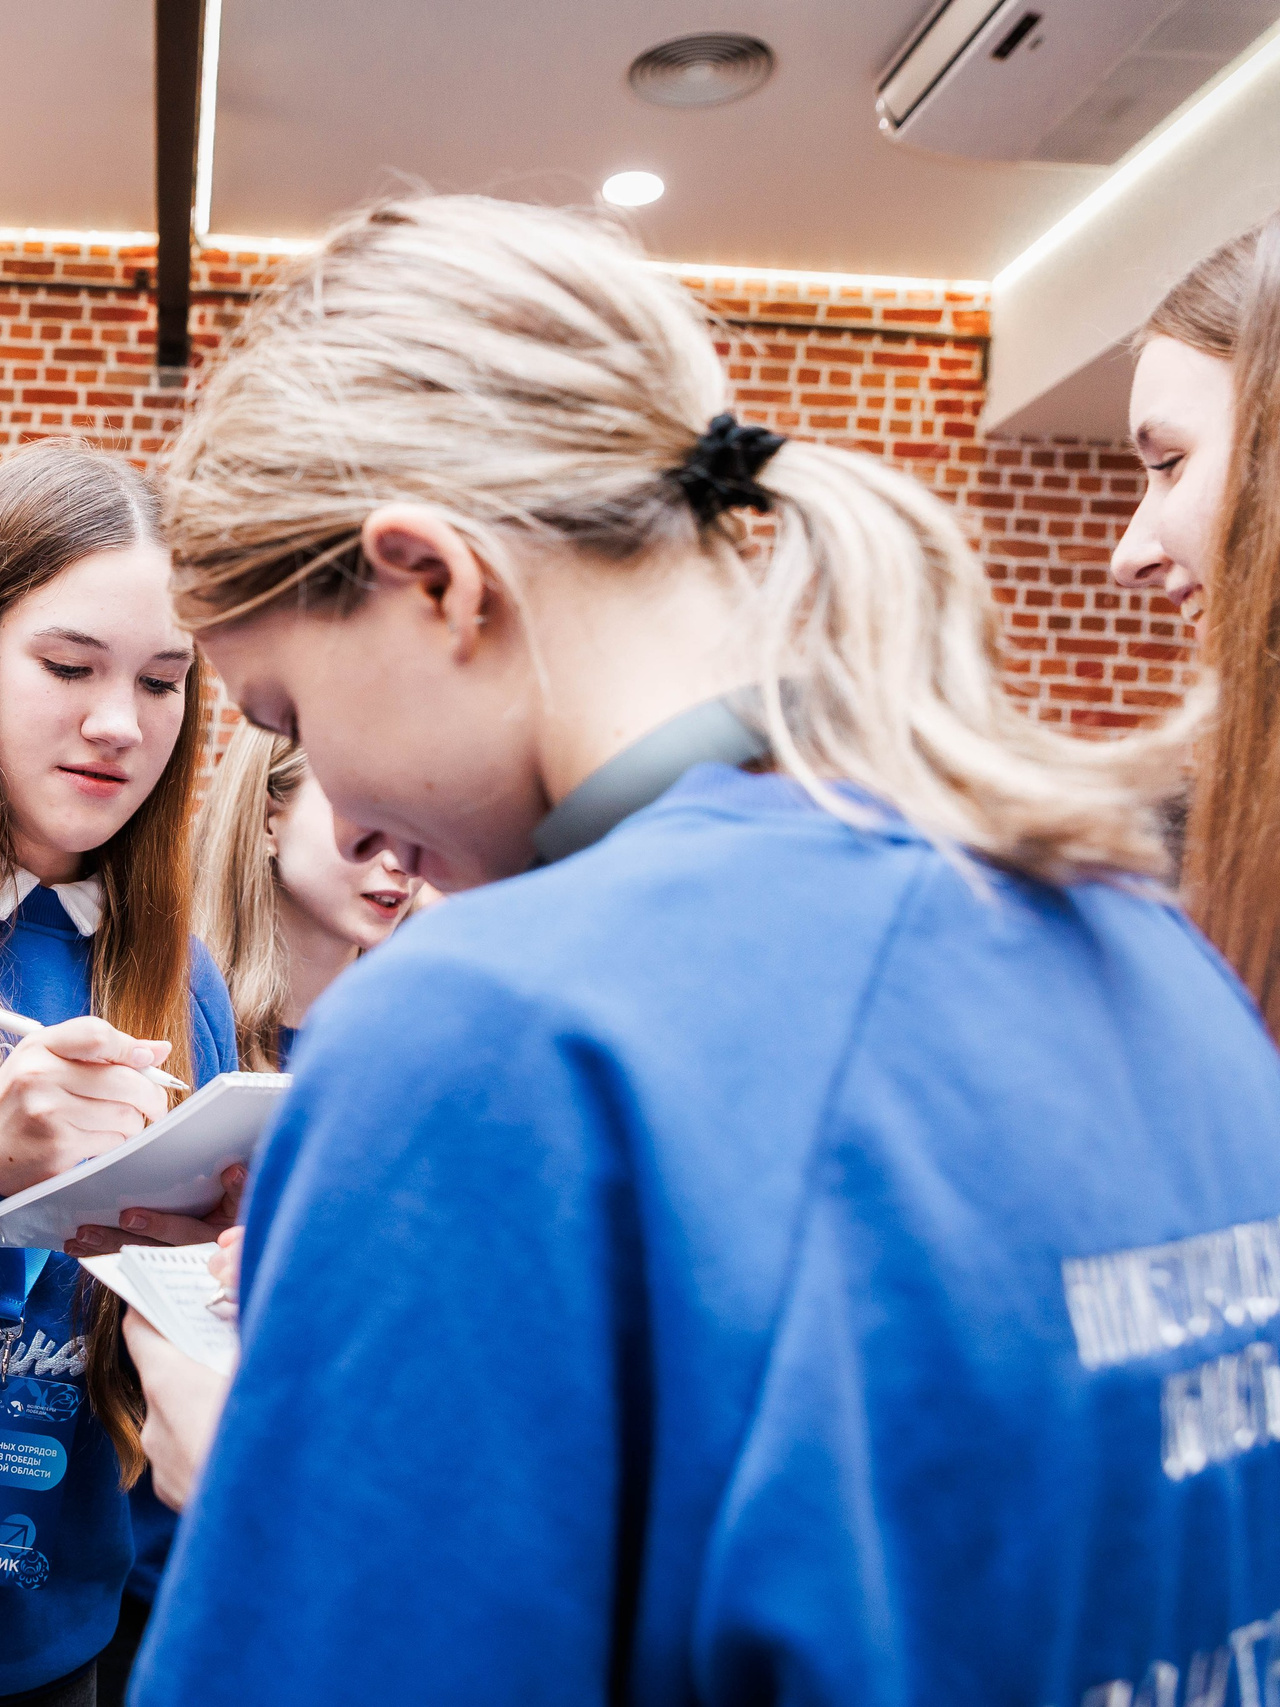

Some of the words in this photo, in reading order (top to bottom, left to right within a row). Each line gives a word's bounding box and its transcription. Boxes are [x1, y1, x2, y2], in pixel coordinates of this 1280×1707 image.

[17, 1444, 58, 1457] ОТРЯДОВ
[5, 1453, 41, 1466] ПОБЕДЫ
[11, 1466, 51, 1478] ОБЛАСТИ
